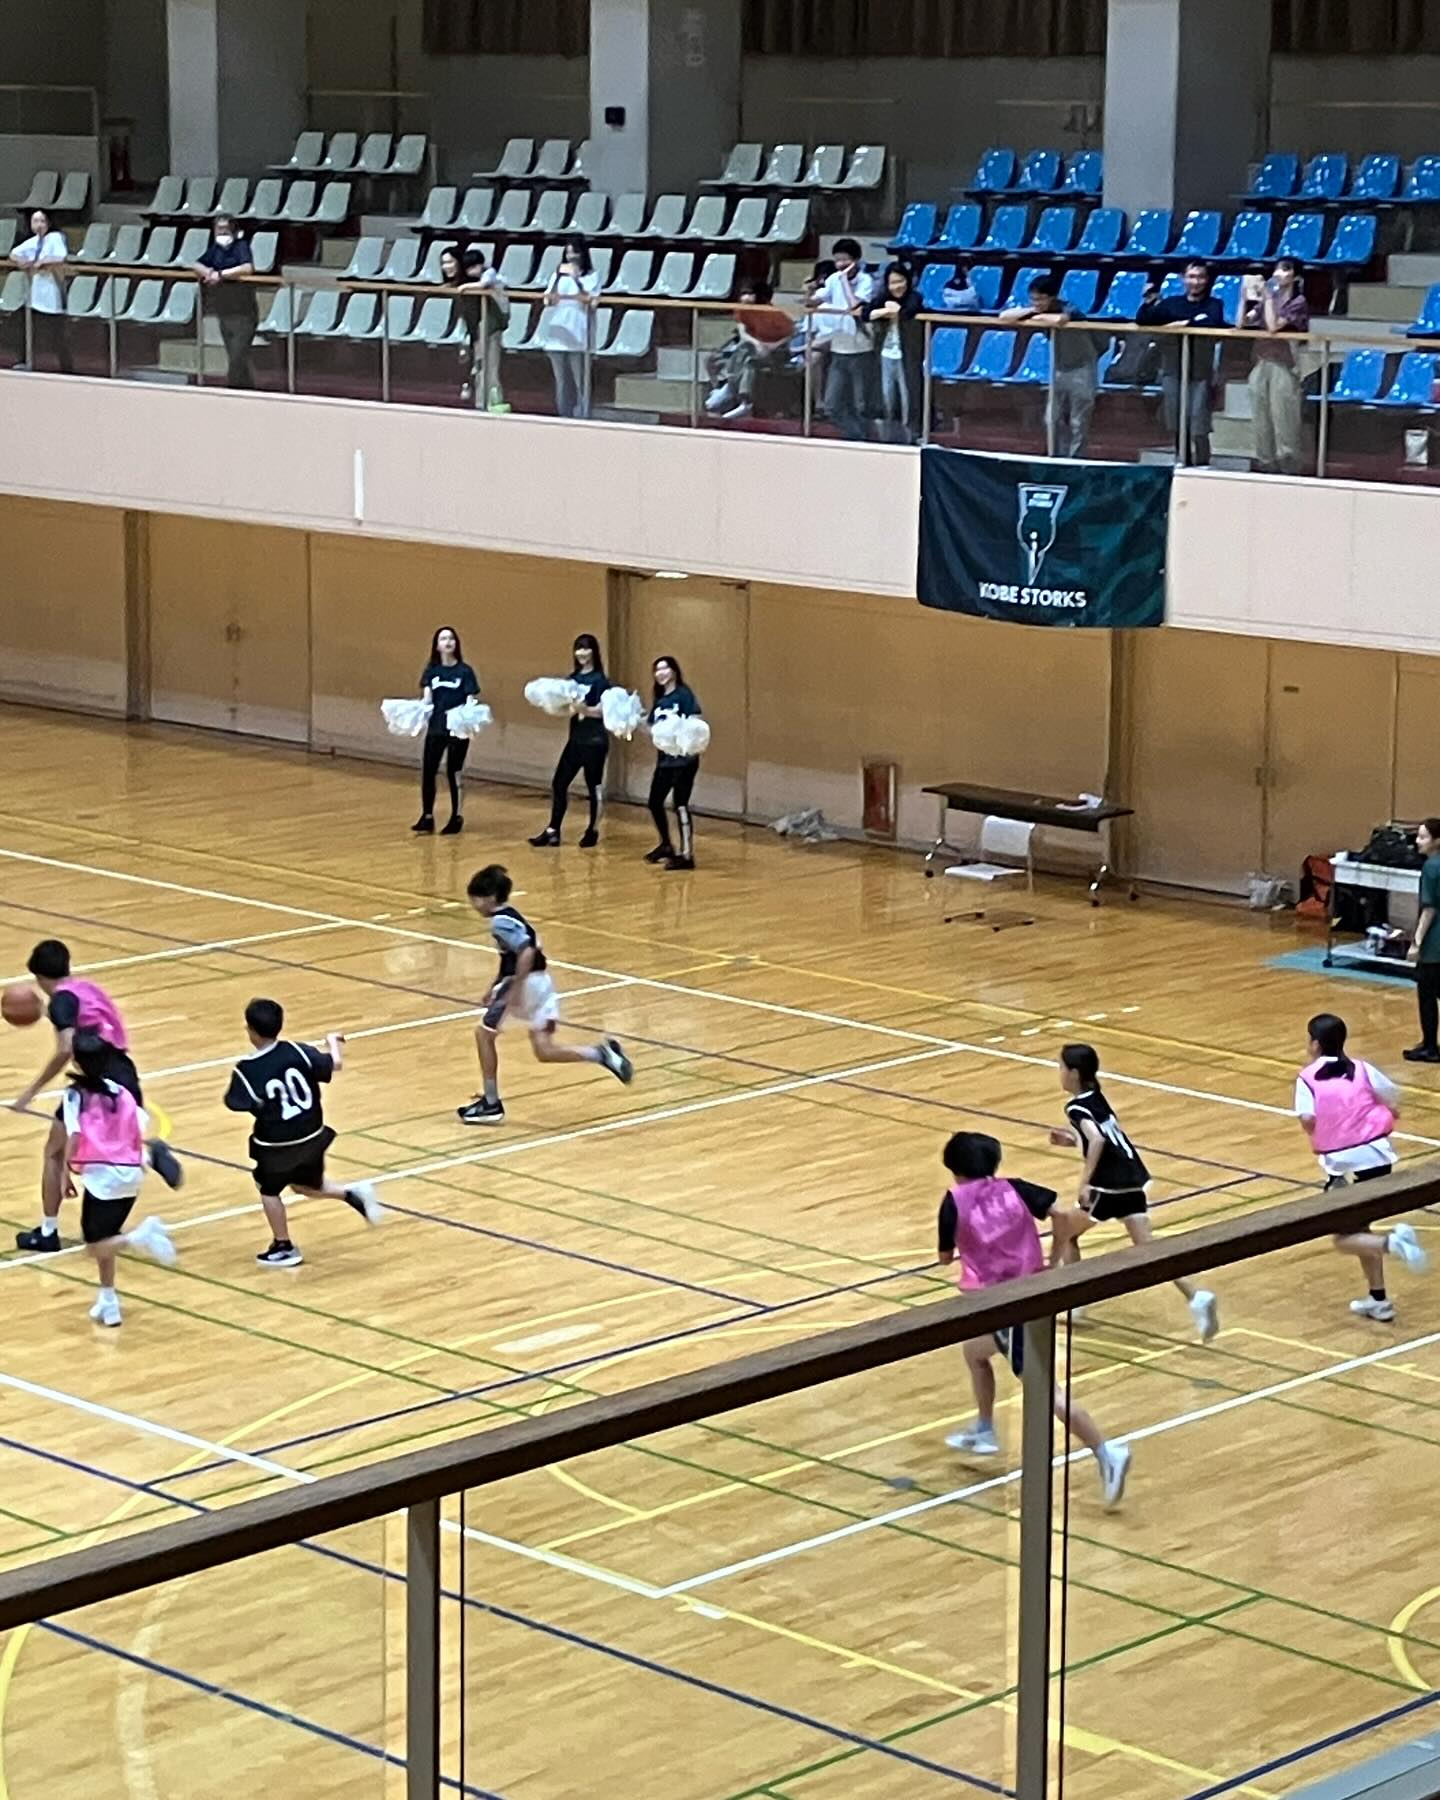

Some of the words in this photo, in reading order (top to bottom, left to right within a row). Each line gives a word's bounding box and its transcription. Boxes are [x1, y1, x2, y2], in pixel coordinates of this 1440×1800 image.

[979, 582, 1019, 603] KOBE
[1020, 587, 1087, 608] STORKS
[265, 1067, 312, 1120] 20
